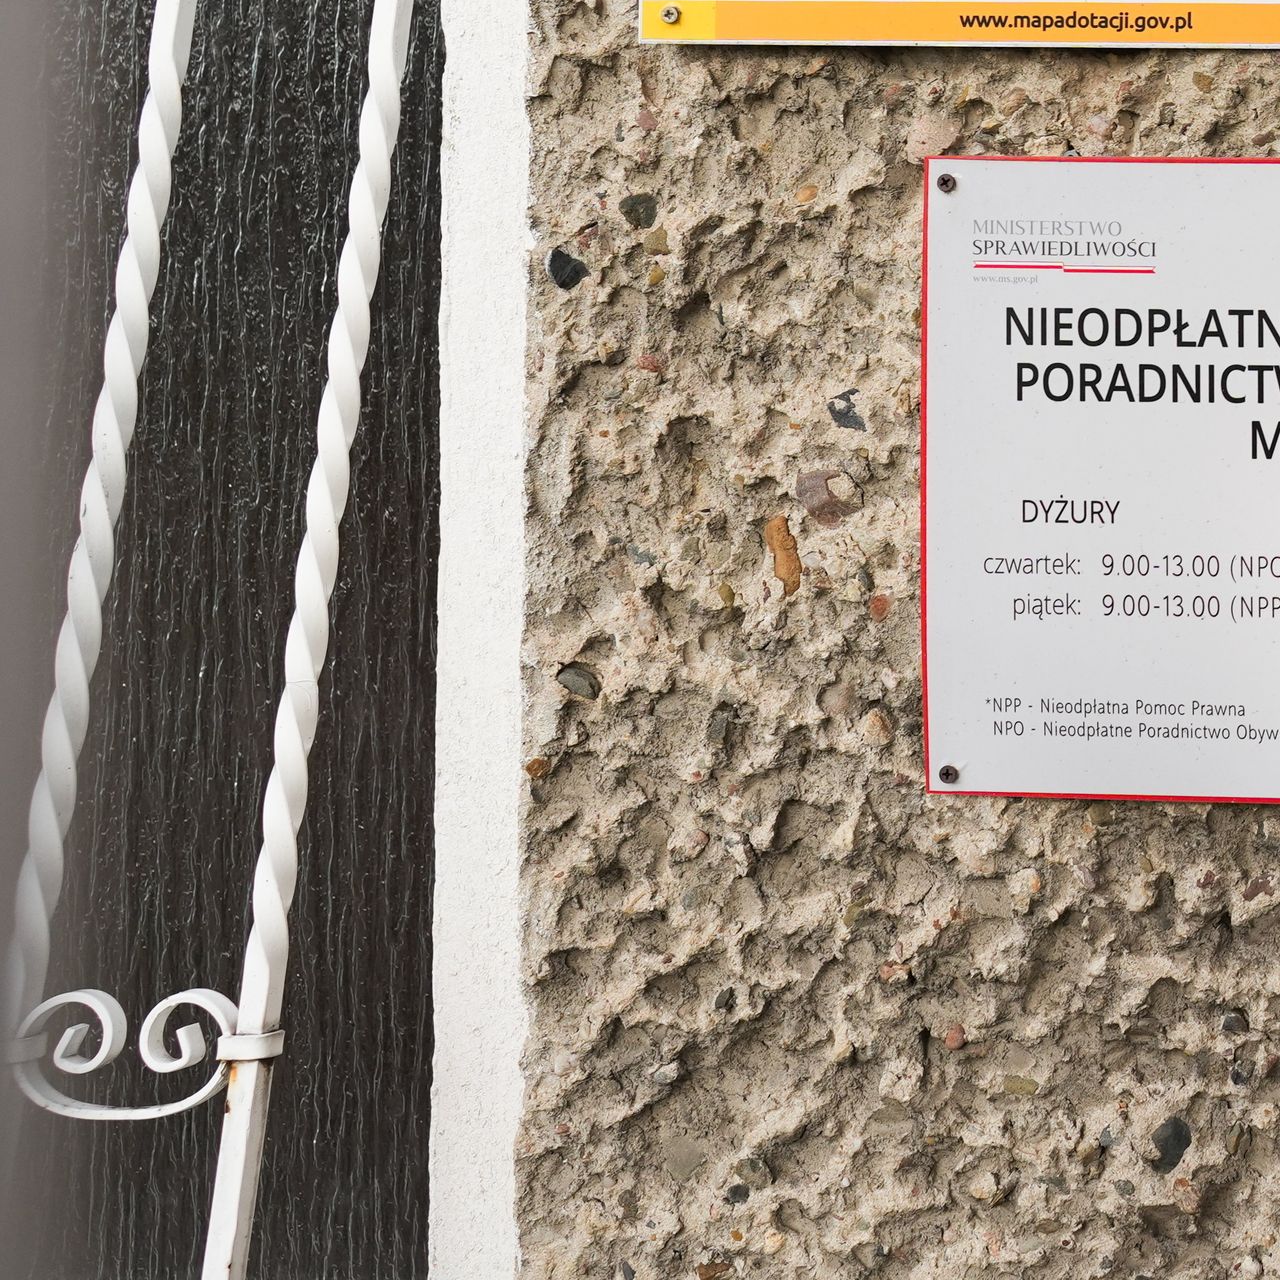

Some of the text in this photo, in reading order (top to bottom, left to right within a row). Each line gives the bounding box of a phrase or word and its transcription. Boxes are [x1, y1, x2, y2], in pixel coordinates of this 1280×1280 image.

[958, 10, 1194, 34] www.mapadotacji.gov.pl
[972, 219, 1123, 237] MINISTERSTWO
[972, 238, 1156, 258] SPRAWIEDLIWOŚCI
[972, 274, 1039, 286] www.ms.gov.pl
[1021, 494, 1121, 525] DYŻURY
[983, 552, 1081, 576] czwartek:
[1101, 553, 1221, 578] 9.00-13.00
[1013, 592, 1081, 621] piątek:
[1101, 593, 1221, 618] 9.00-13.00
[1040, 698, 1246, 719] Nieodpłatna Pomoc Prawna
[993, 720, 1025, 737] NPO
[1043, 721, 1133, 742] Nieodpłatne
[1138, 722, 1231, 740] Poradnictwo
